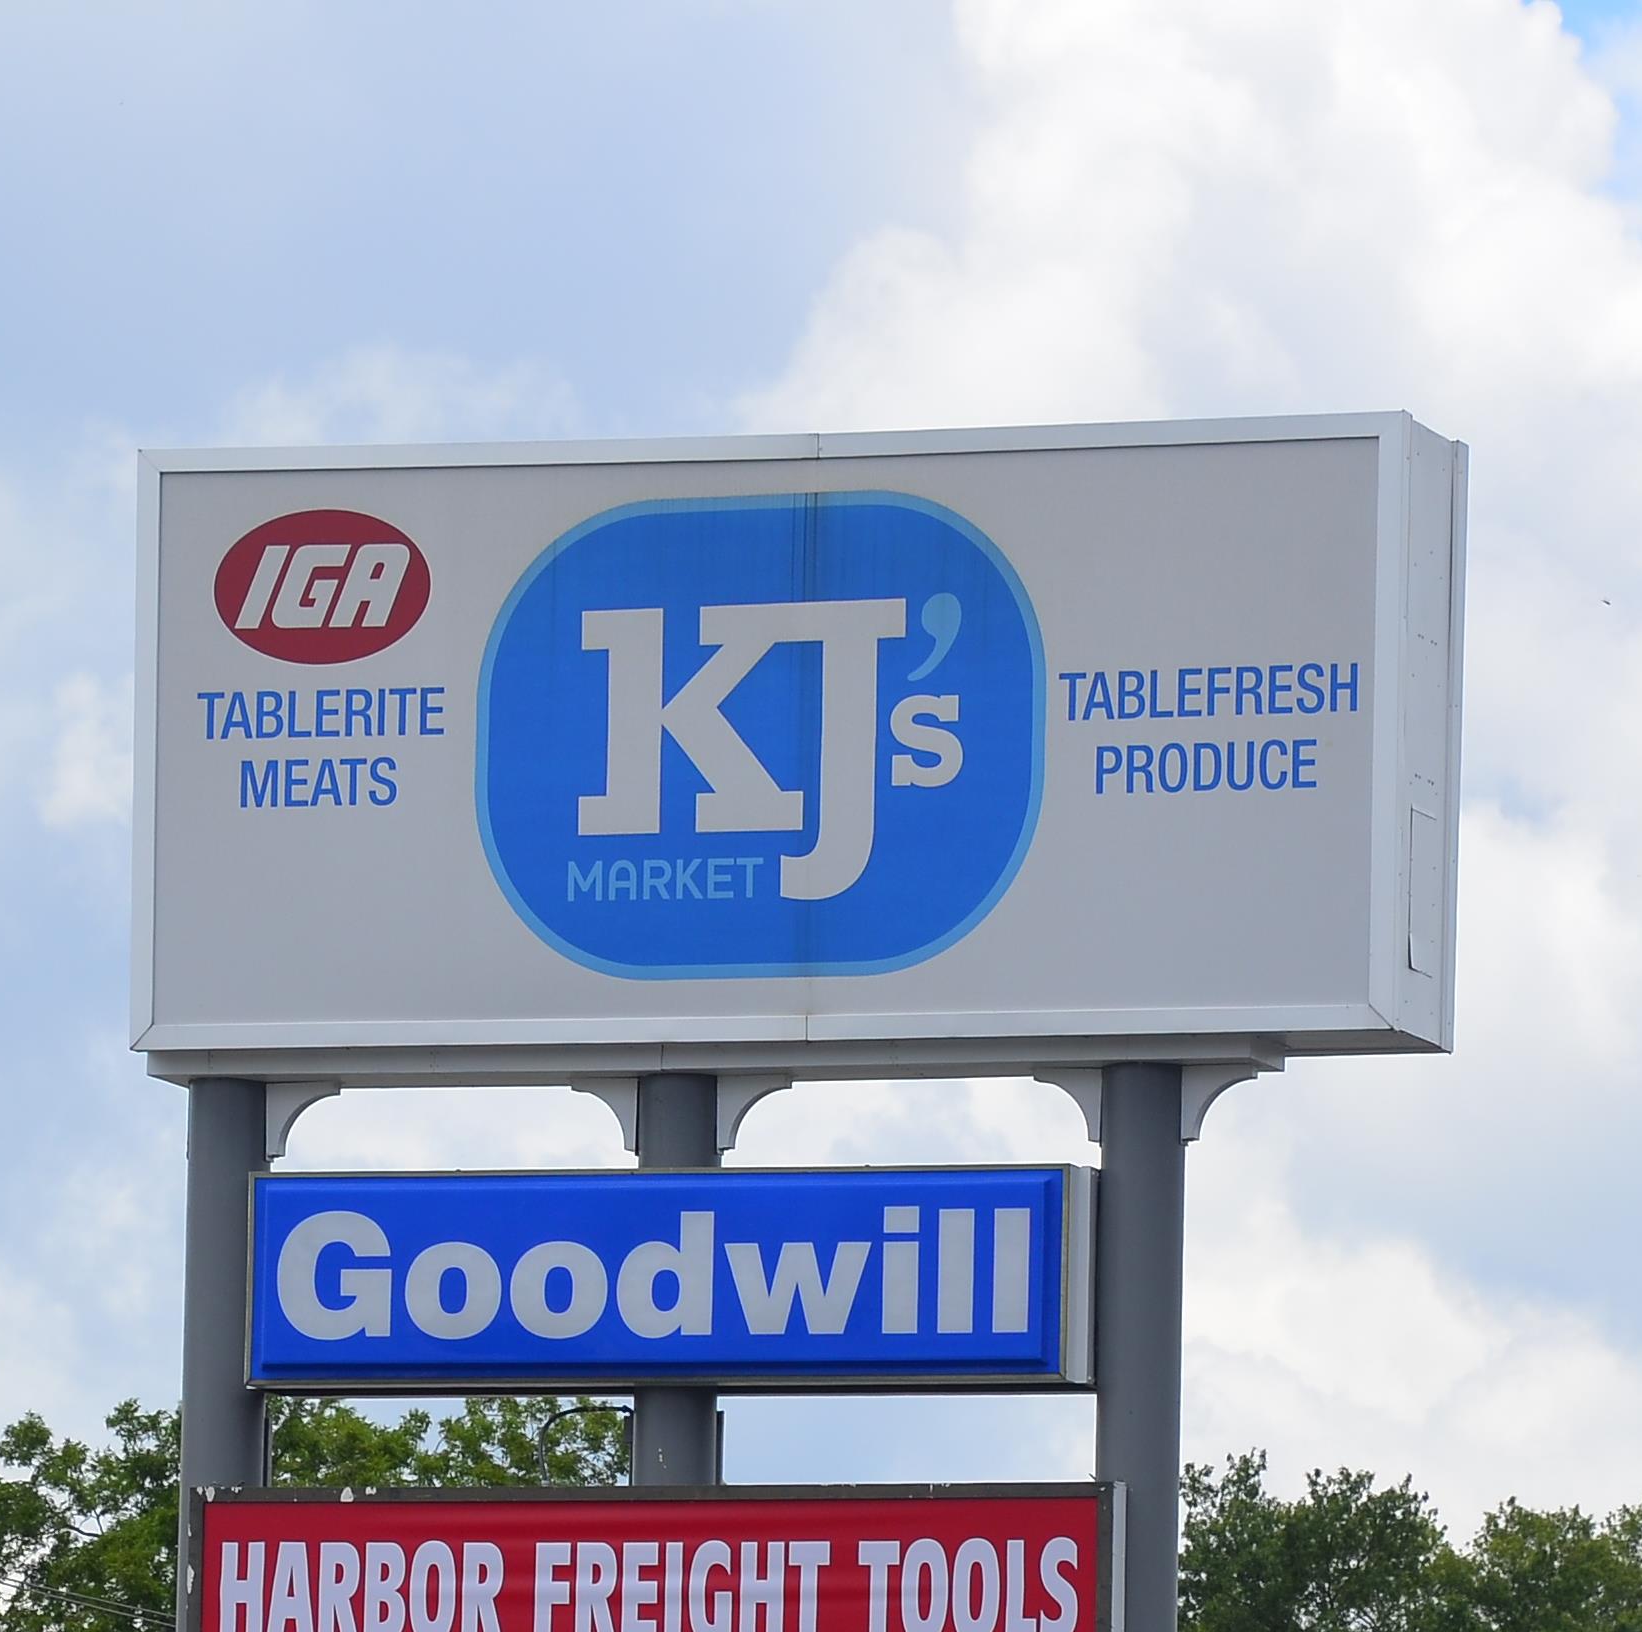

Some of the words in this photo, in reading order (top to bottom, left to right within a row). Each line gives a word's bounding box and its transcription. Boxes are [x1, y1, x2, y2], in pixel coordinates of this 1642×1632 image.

[233, 541, 410, 630] IGA
[197, 685, 446, 742] TABLERITE
[1059, 662, 1360, 724] TABLEFRESH
[577, 592, 964, 901] KJ's
[1094, 738, 1318, 796] PRODUCE
[239, 757, 399, 809] MEATS
[565, 857, 765, 903] MARKET
[276, 1205, 1033, 1341] Goodwill
